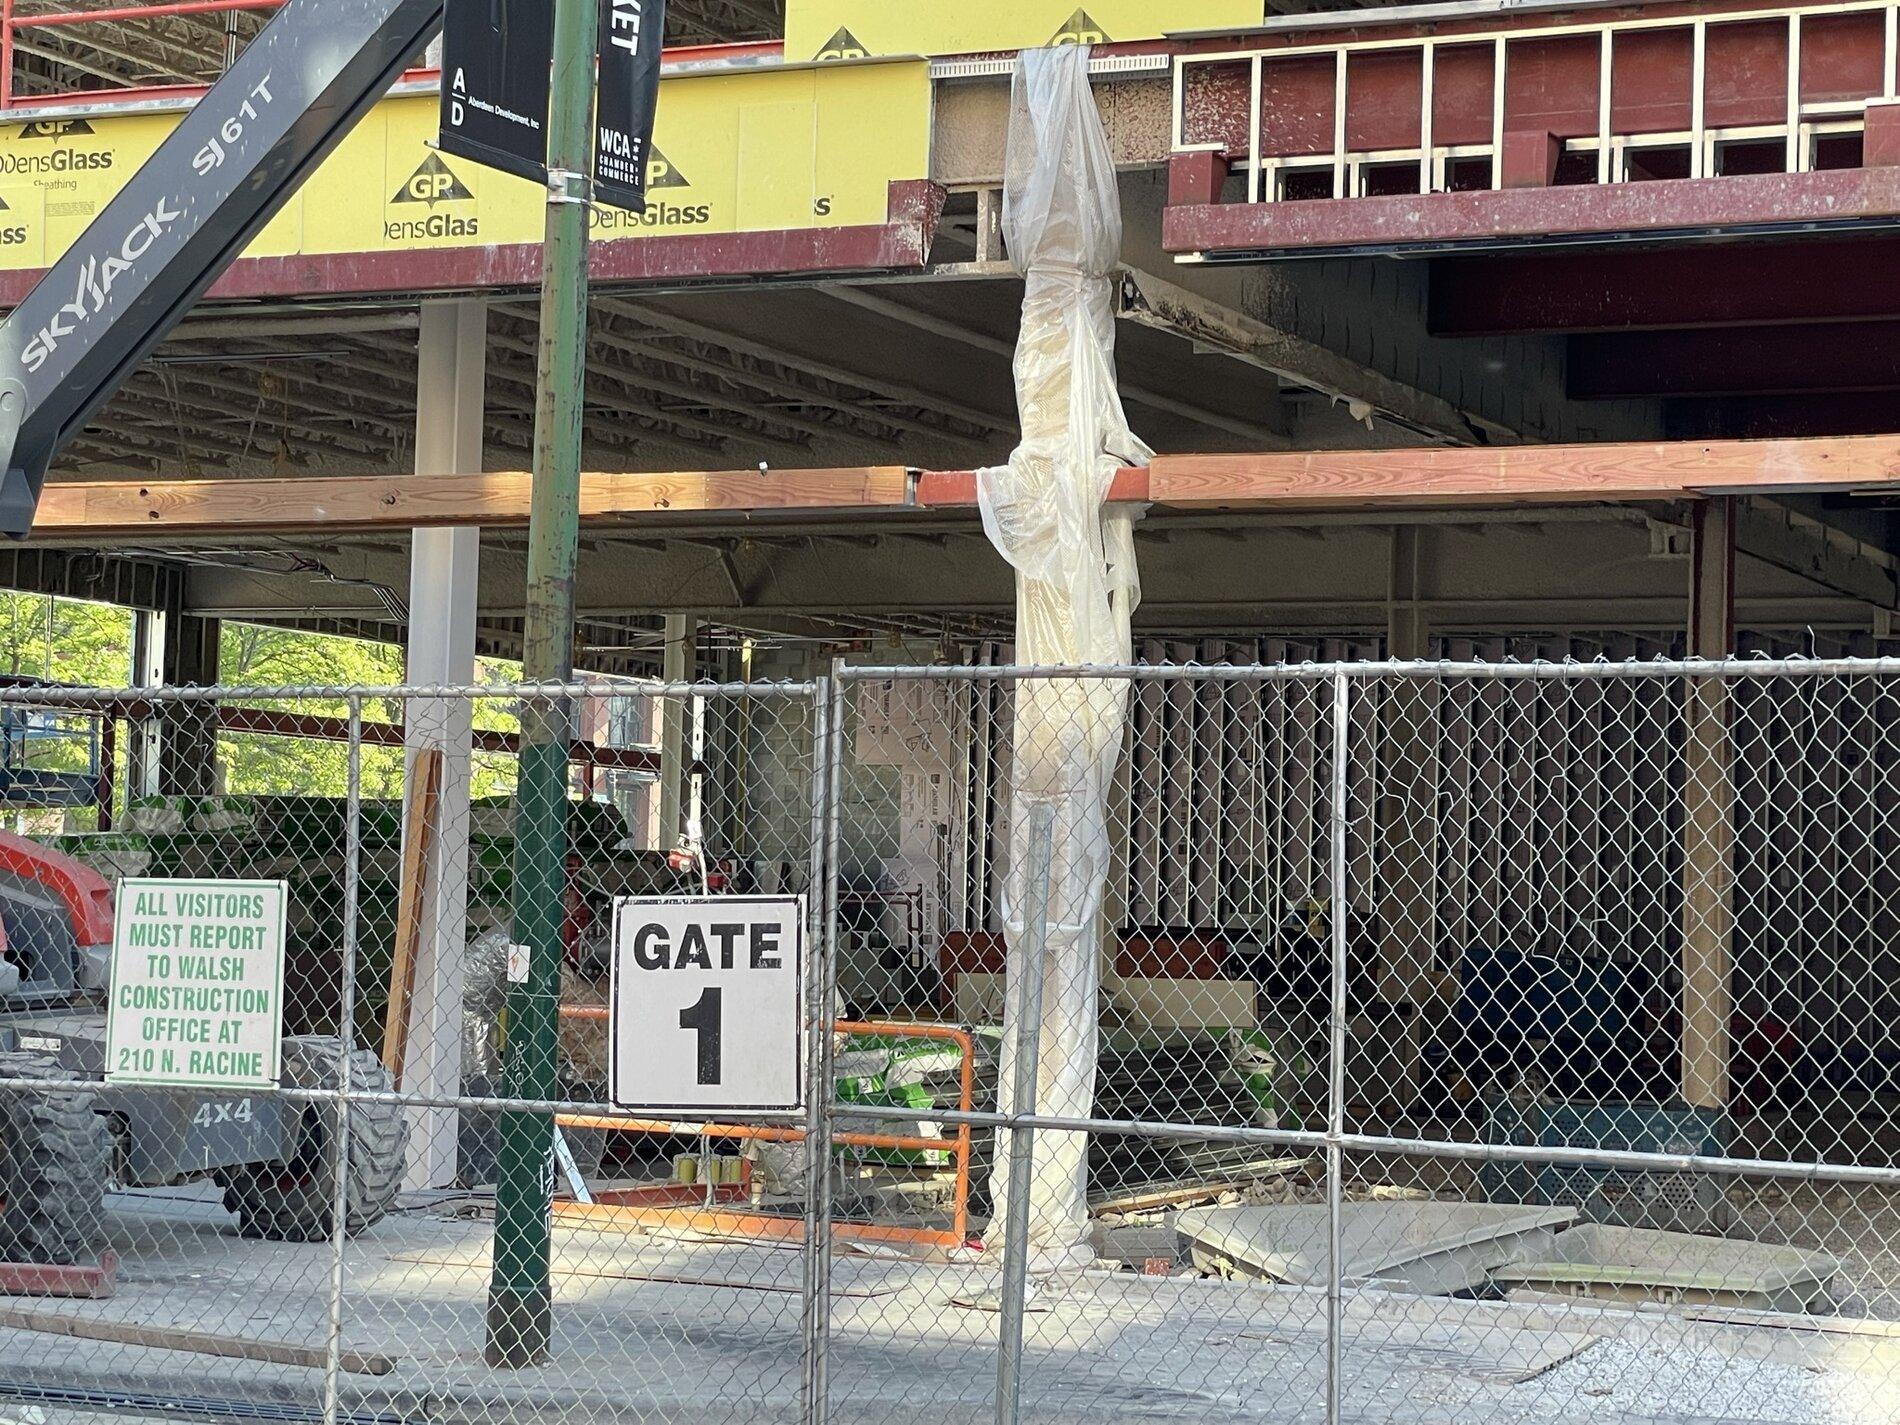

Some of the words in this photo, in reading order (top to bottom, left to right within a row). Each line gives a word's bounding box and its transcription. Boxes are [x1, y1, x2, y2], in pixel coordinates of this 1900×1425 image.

[453, 67, 466, 93] A
[452, 100, 464, 126] D
[468, 95, 495, 113] Aberdeen
[600, 127, 631, 159] WCA
[598, 165, 639, 186] COMMERCE
[599, 154, 635, 173] CHAMBER
[646, 160, 668, 186] P
[409, 173, 454, 199] GP
[20, 196, 182, 374] SKYJACK
[134, 892, 168, 916] ALL
[175, 893, 264, 919] VISITORS
[129, 923, 183, 948] MUST
[189, 925, 267, 950] REPORT
[633, 923, 782, 971] GATE
[147, 954, 171, 979] TO
[178, 955, 245, 981] WALSH
[120, 984, 269, 1013] CONSTRUCTION
[142, 1016, 211, 1043] OFFICE
[217, 1020, 243, 1044] AT
[679, 987, 722, 1085] 1
[118, 1047, 155, 1072] 210
[161, 1049, 181, 1073] N.
[188, 1050, 263, 1077] RACINE
